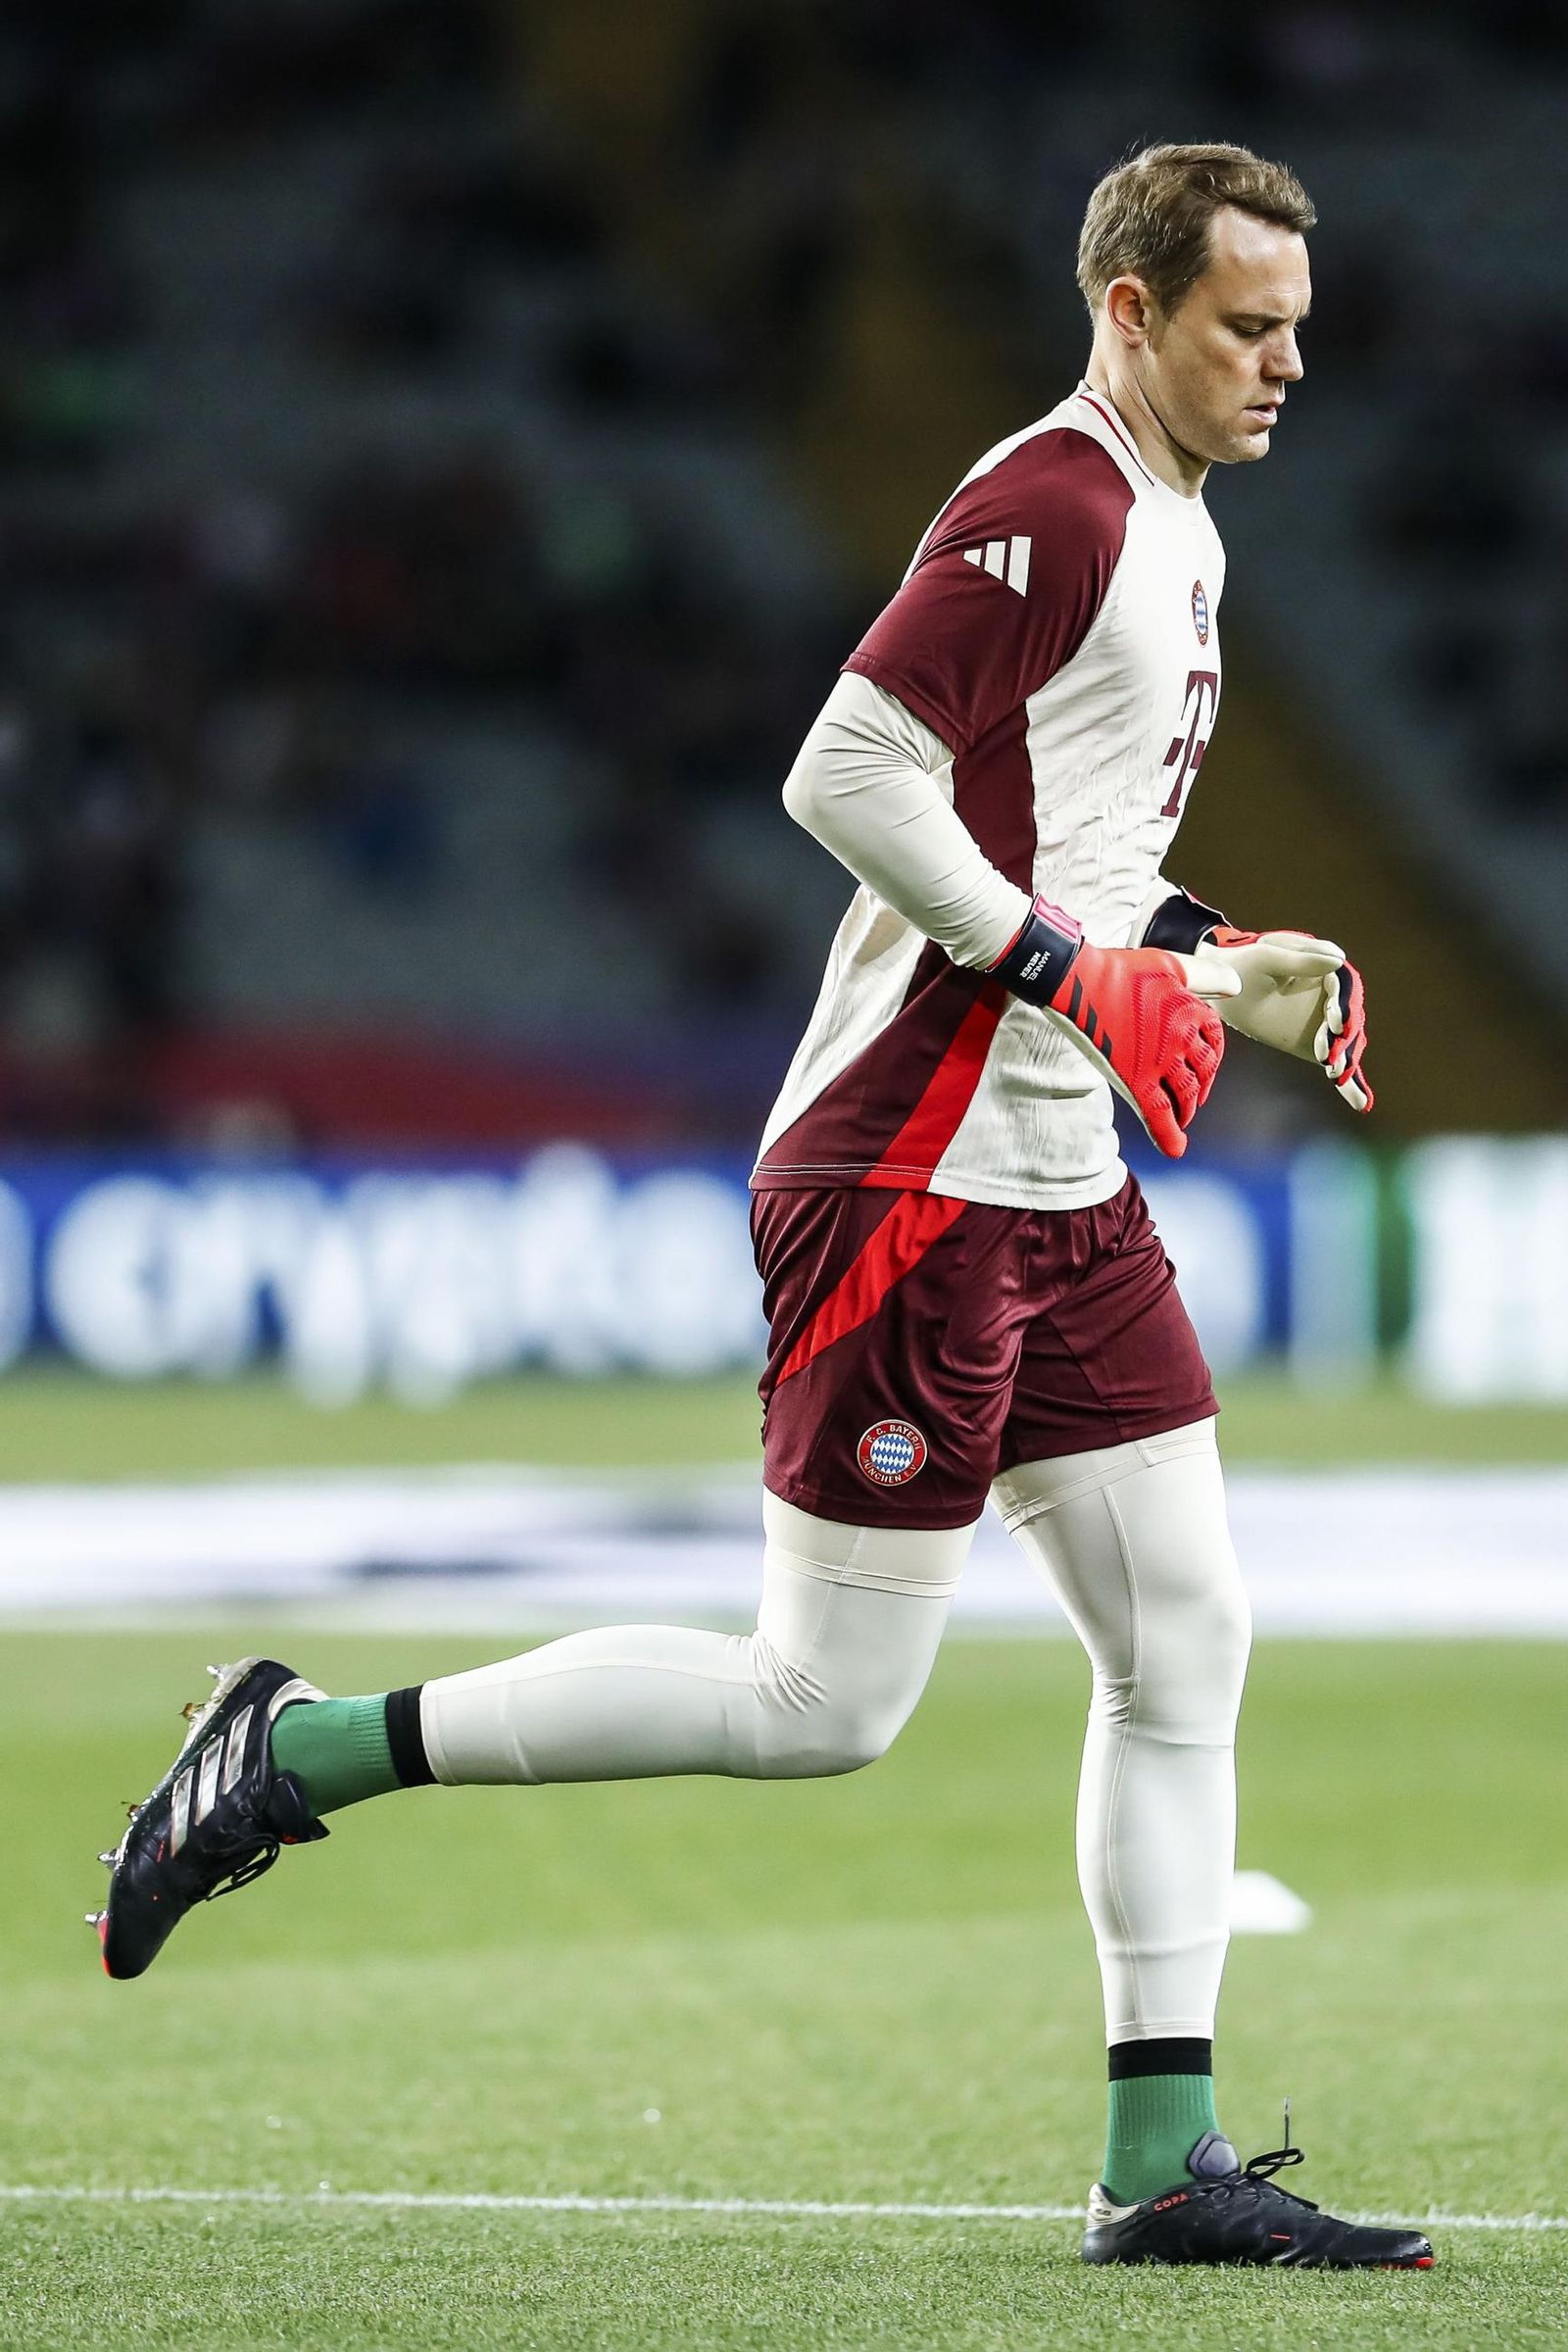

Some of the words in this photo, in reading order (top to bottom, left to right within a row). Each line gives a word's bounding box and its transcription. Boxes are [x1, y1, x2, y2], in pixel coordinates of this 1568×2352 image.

[1019, 951, 1042, 978] NEUER
[1026, 951, 1051, 981] MANUEL
[1153, 2193, 1189, 2211] COPA
